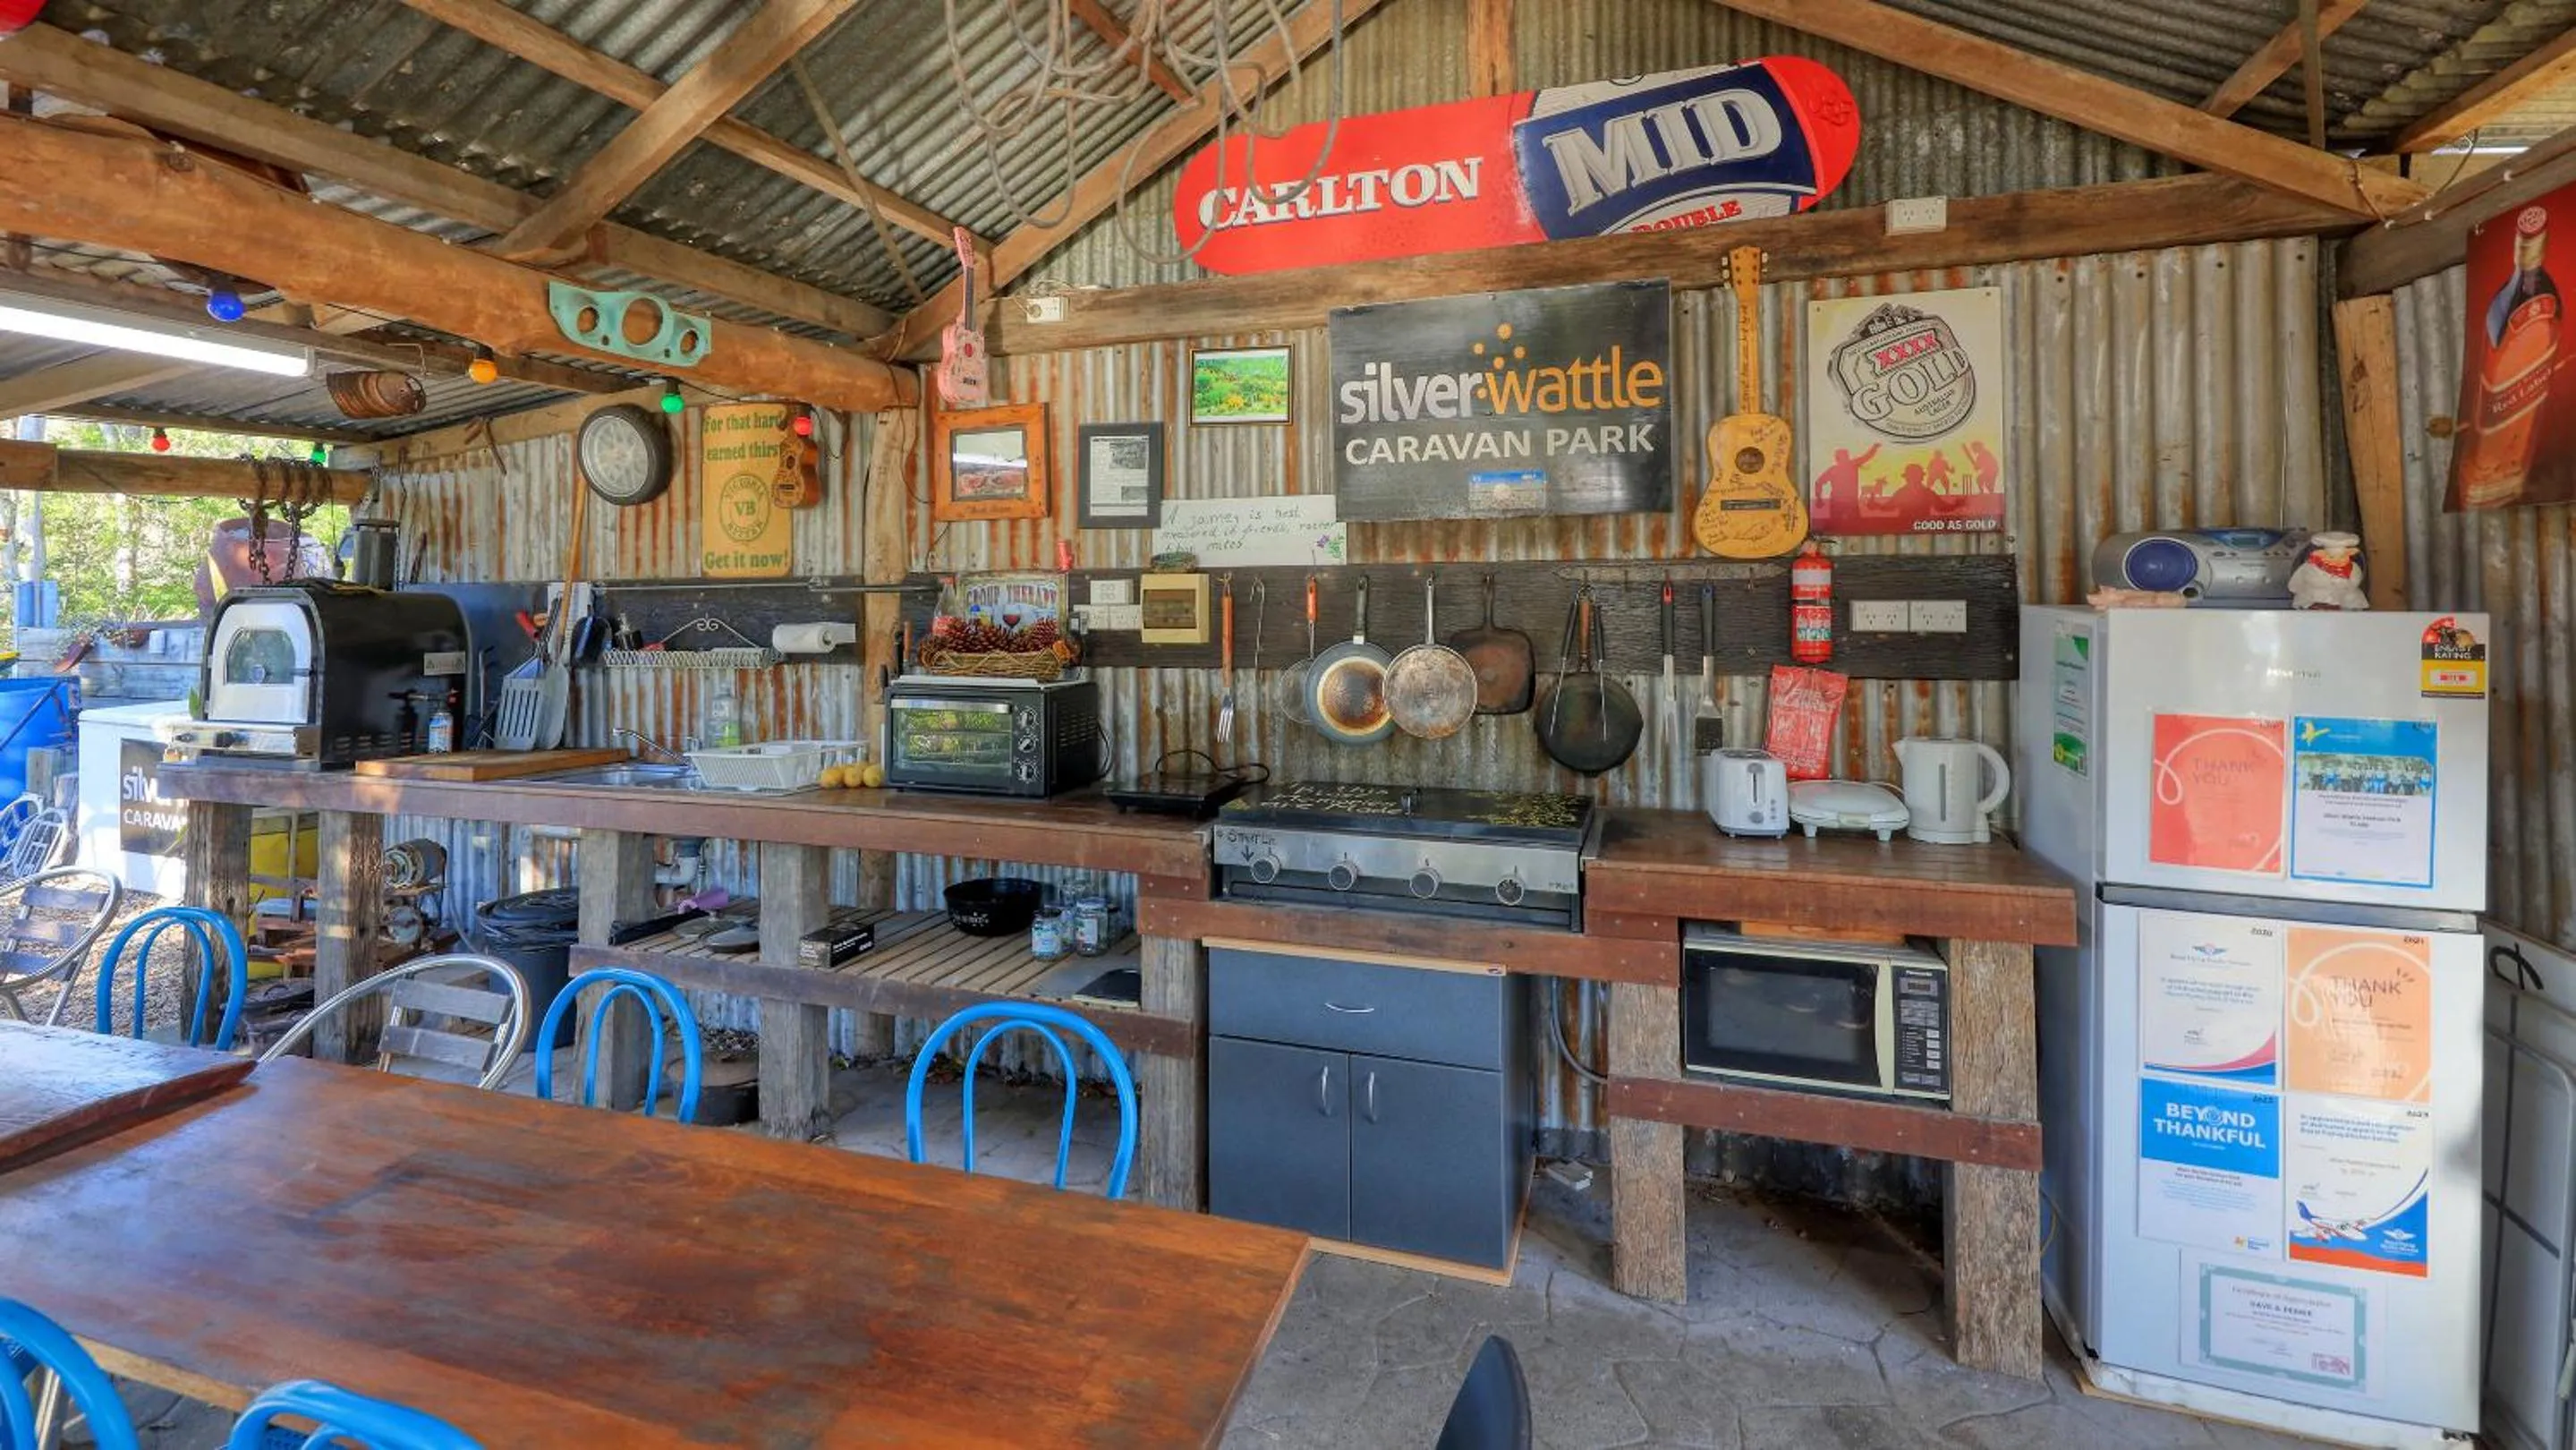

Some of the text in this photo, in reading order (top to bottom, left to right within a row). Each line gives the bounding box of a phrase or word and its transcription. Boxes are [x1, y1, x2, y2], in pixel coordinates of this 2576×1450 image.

[1542, 88, 1784, 218] MID
[1197, 156, 1484, 231] CARLTON
[1875, 331, 1941, 371] XXXX
[1339, 345, 1663, 423] silver wattle
[1850, 348, 1970, 421] GOLD
[703, 415, 724, 433] For
[727, 413, 752, 431] that
[706, 442, 780, 462] earned thirs
[1344, 422, 1656, 467] CARAVAN PARK
[734, 500, 757, 516] VB
[1914, 518, 1996, 531] GOOD AS GOLD
[704, 550, 788, 570] Get it now!
[123, 765, 174, 806] silv
[2192, 772, 2232, 787] YOU
[2330, 974, 2402, 995] THANK
[2330, 988, 2374, 1009] YOU
[2165, 1102, 2256, 1129] BEYOND
[2153, 1118, 2266, 1149] THANKFUL
